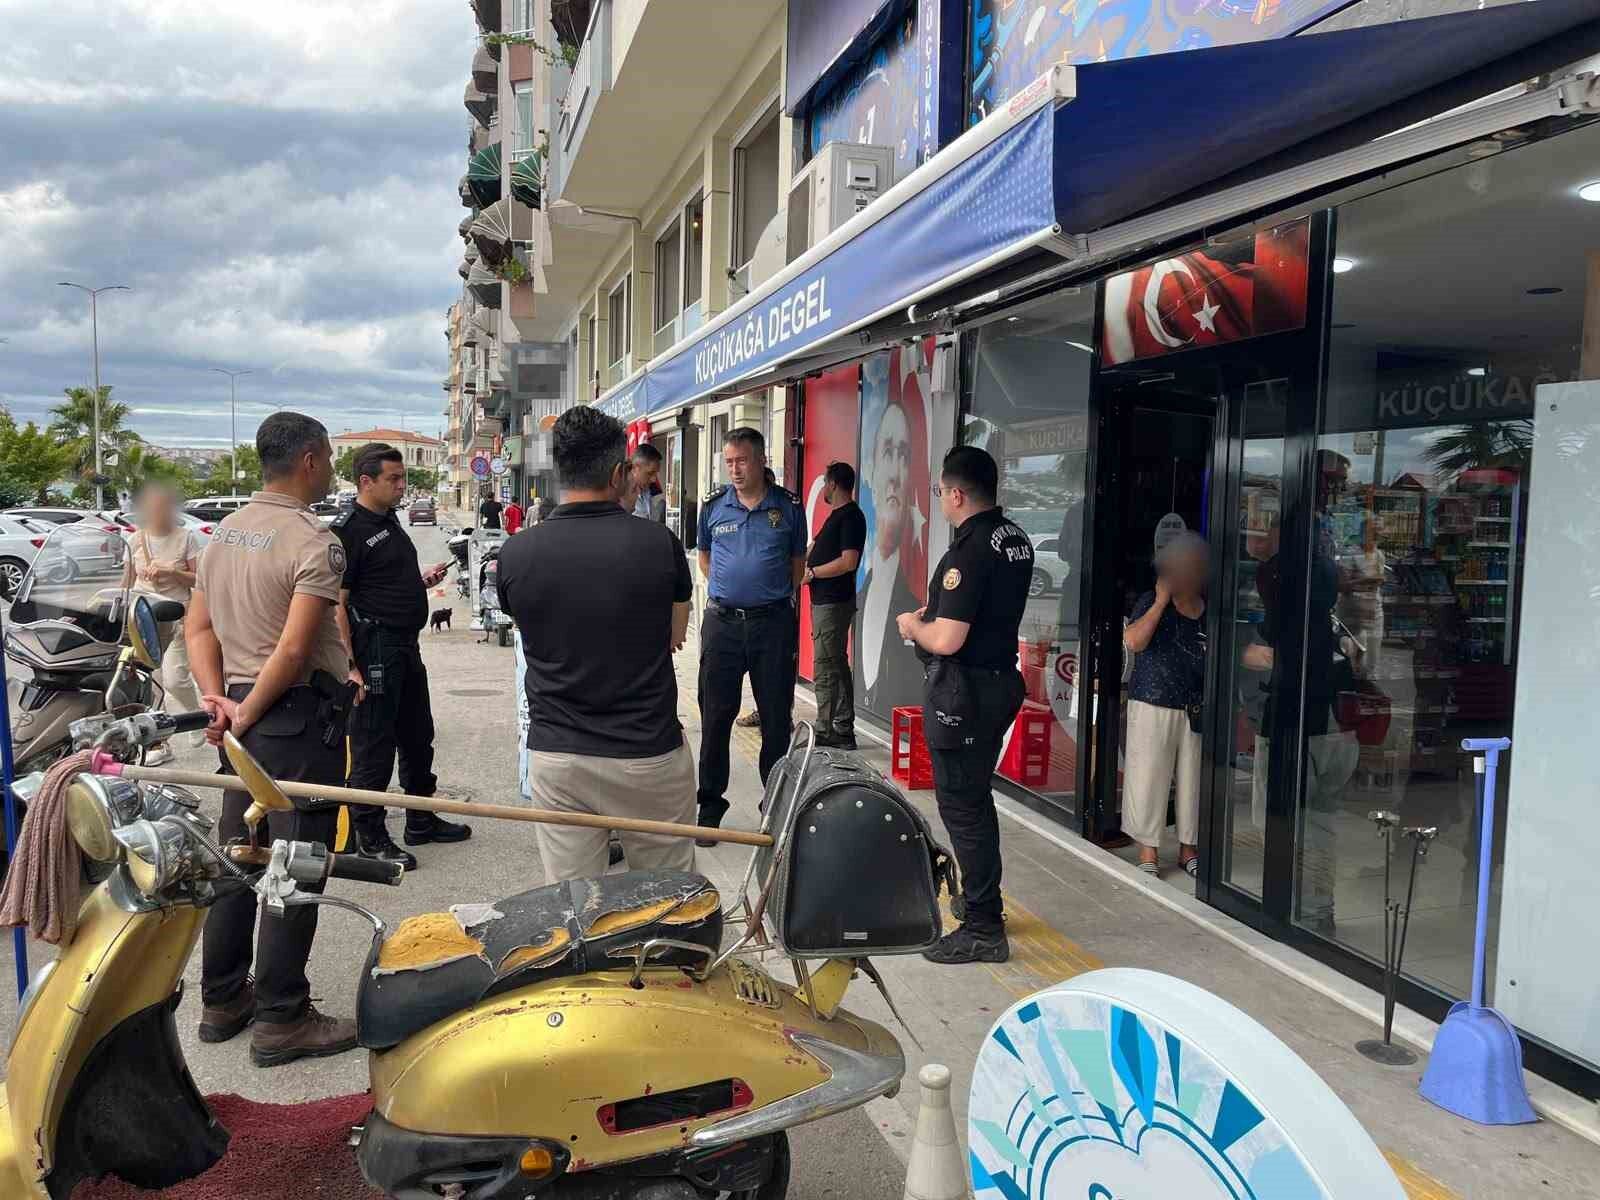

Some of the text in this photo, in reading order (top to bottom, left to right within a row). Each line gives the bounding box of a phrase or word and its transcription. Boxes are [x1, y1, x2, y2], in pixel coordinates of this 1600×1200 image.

[695, 275, 832, 385] KÜÇÜKAĞA DEGEL
[212, 526, 277, 552] BEKÇİ
